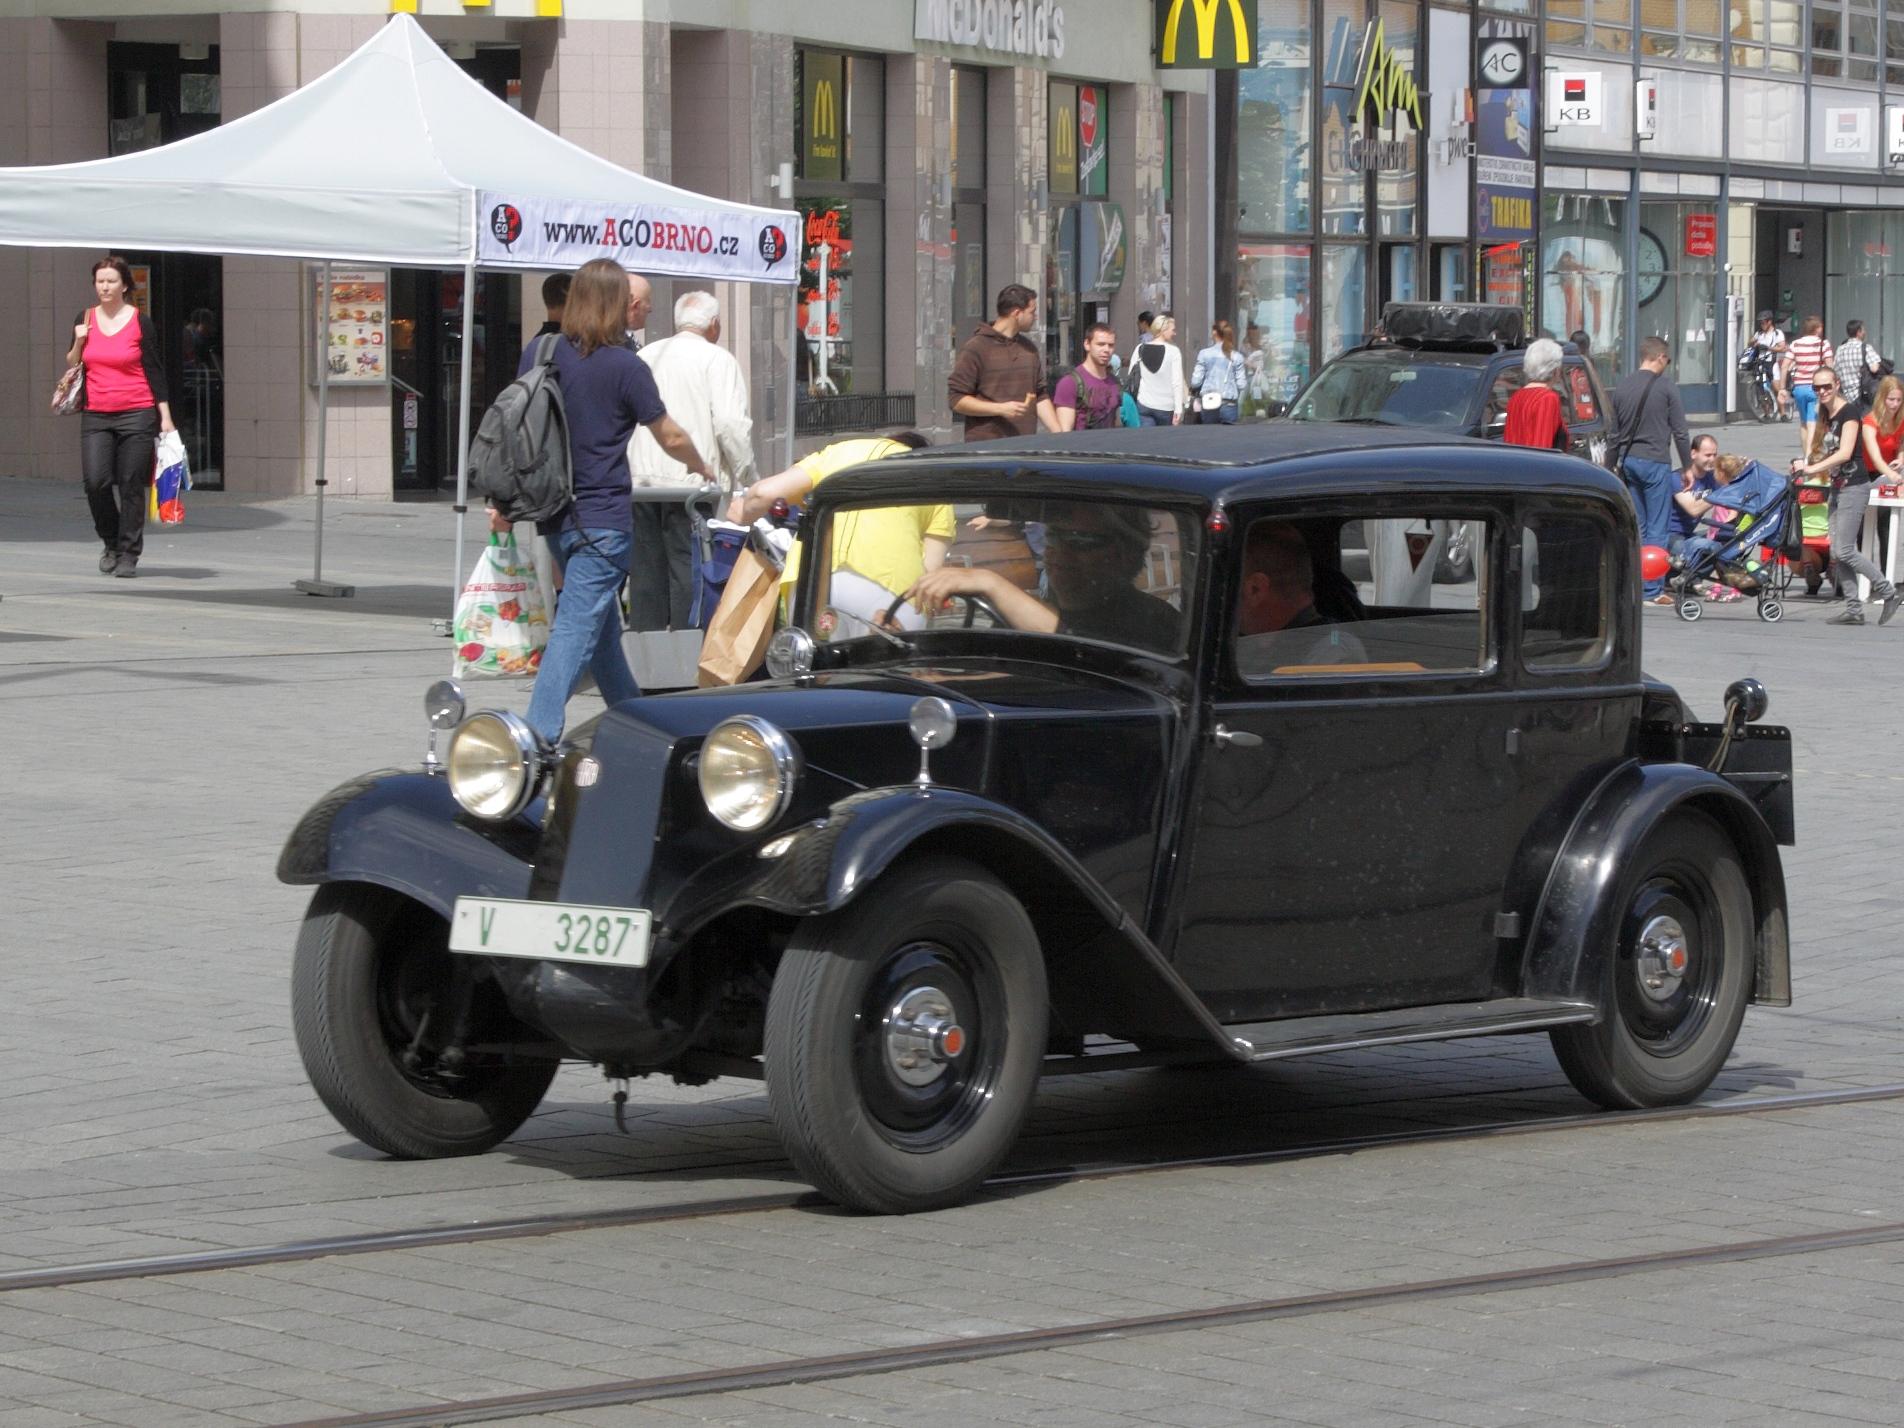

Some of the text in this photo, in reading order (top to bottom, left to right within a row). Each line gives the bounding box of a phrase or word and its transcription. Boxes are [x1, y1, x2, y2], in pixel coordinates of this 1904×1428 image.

[1559, 108, 1591, 121] KB
[1491, 196, 1531, 229] TRAFIKA
[543, 216, 739, 257] www.ACOBRNO.cz
[481, 906, 631, 958] V 3287
